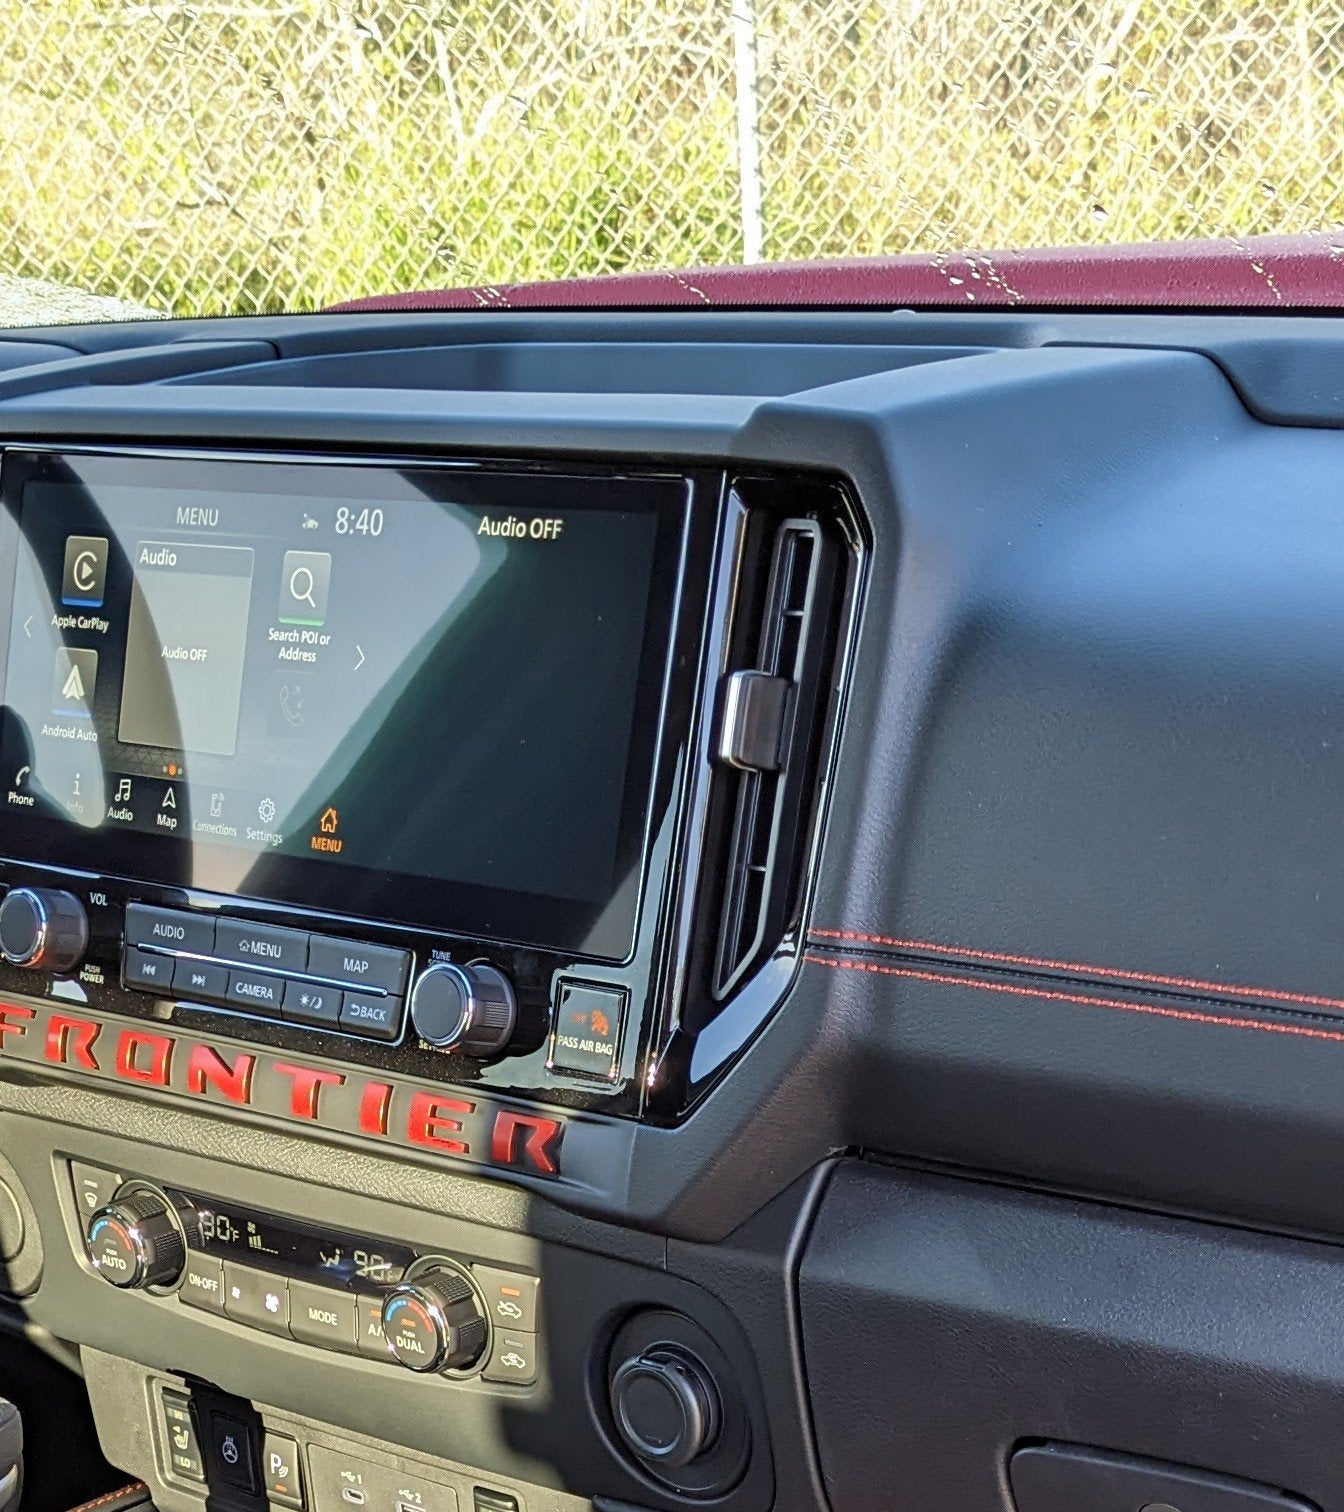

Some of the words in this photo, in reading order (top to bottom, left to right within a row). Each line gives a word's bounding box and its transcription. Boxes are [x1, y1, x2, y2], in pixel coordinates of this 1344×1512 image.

[176, 506, 219, 526] MENU
[335, 507, 384, 536] 8:40
[477, 516, 527, 538] Audio
[529, 518, 563, 540] OFF
[139, 548, 177, 567] Audio
[51, 614, 76, 630] Apple
[77, 616, 109, 634] CarPlay
[268, 628, 299, 643] Search
[301, 630, 318, 644] POI
[319, 634, 331, 645] or
[160, 646, 188, 660] Audio
[189, 649, 208, 662] OFF
[278, 647, 317, 663] Address
[41, 724, 72, 740] Android
[74, 729, 98, 743] Auto
[8, 791, 34, 807] Phone
[107, 806, 134, 822] Audio
[157, 813, 177, 830] Map
[192, 819, 237, 838] Connections
[246, 827, 283, 845] Settings
[311, 836, 342, 853] MENU
[89, 891, 108, 906] VOL
[153, 923, 185, 940] AUDIO
[250, 942, 282, 959] MENU
[431, 949, 451, 962] TUNE
[343, 957, 369, 974] MAP
[79, 971, 104, 985] POWER
[236, 982, 273, 1000] CAMERA
[359, 1006, 387, 1022] BACK
[558, 1036, 578, 1048] PASS
[579, 1040, 594, 1052] AIR
[595, 1042, 613, 1056] BAG
[102, 1254, 127, 1271] AUTO
[308, 1307, 338, 1327] MODE
[367, 1323, 385, 1338] A/
[395, 1335, 426, 1354] DUAL
[414, 1492, 422, 1504] 2
